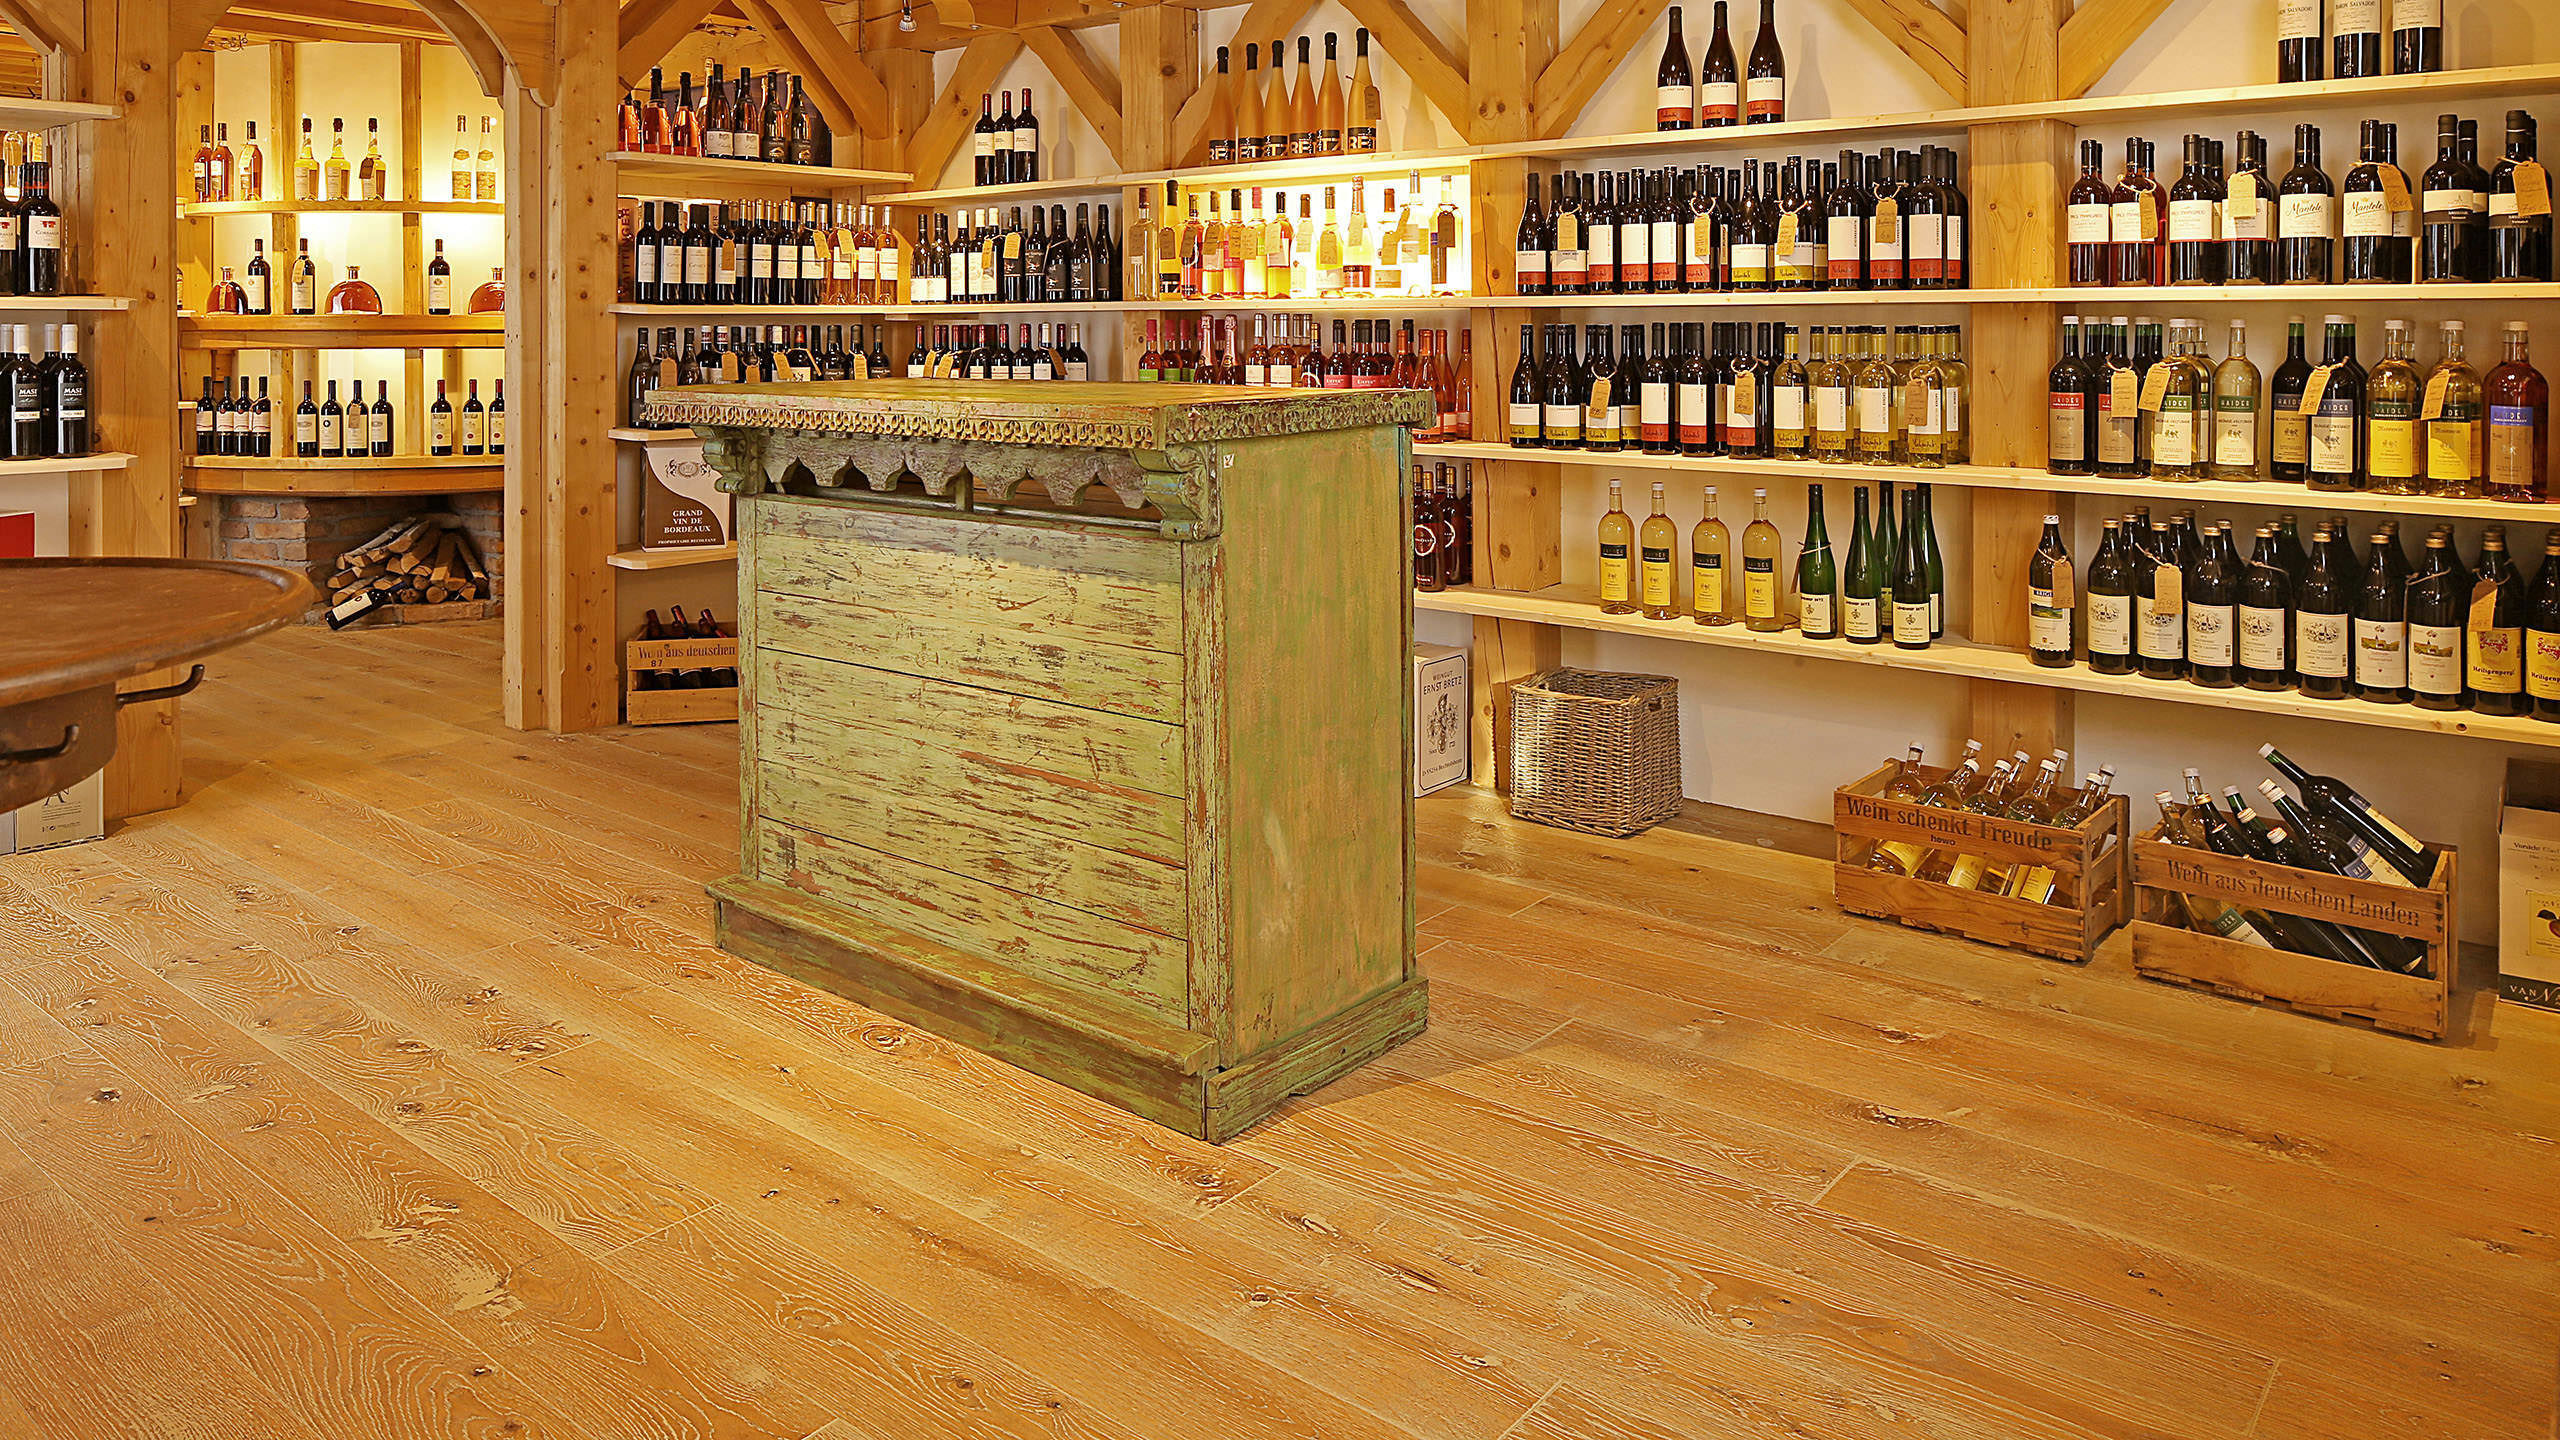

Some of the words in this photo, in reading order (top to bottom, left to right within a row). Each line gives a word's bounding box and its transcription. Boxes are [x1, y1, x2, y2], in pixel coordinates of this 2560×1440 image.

[672, 509, 703, 517] GRAND
[664, 525, 711, 534] BORDEAUX
[665, 647, 684, 657] aus
[1432, 670, 1453, 681] WEINGUT
[1423, 682, 1442, 695] ERNST
[1443, 676, 1462, 690] BRETZ
[1847, 796, 1889, 822] Wein
[1897, 808, 1972, 836] schenkt
[1980, 819, 2054, 851] Freude
[2168, 859, 2209, 887] Wein
[2215, 874, 2247, 894] aus
[2253, 876, 2345, 913] deutschen
[2349, 894, 2420, 927] Landen
[2510, 984, 2537, 997] VAN
